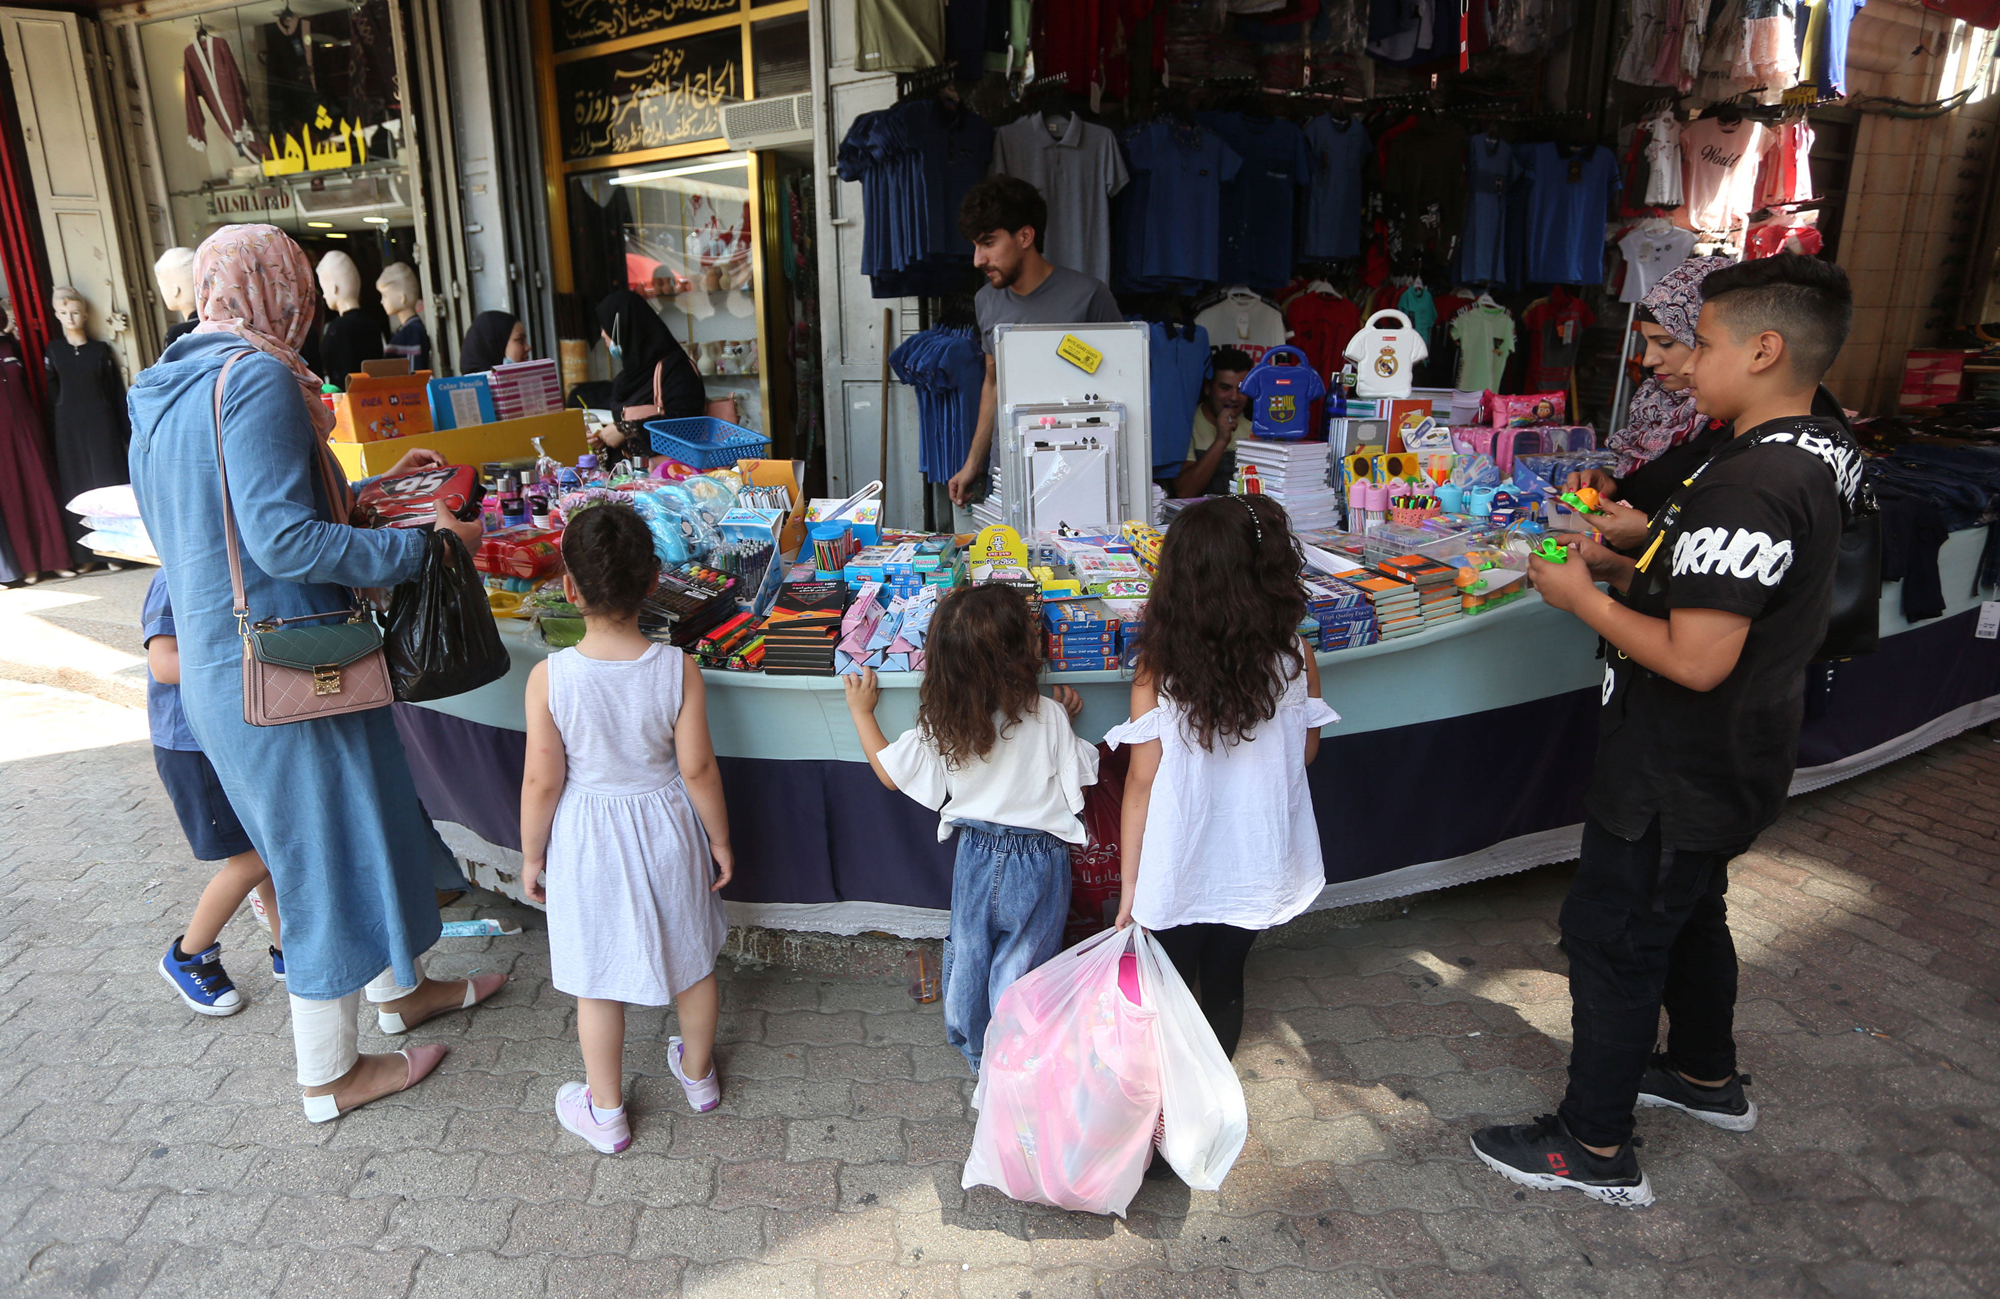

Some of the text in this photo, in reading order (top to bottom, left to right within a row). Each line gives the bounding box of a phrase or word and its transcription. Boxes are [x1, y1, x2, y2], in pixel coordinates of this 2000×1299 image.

[691, 58, 736, 110] الحاج
[262, 104, 366, 177] الشاهد
[1701, 145, 1741, 168] World
[216, 191, 290, 214] ALSHAD
[395, 471, 449, 493] 95
[1335, 612, 1354, 620] Quality
